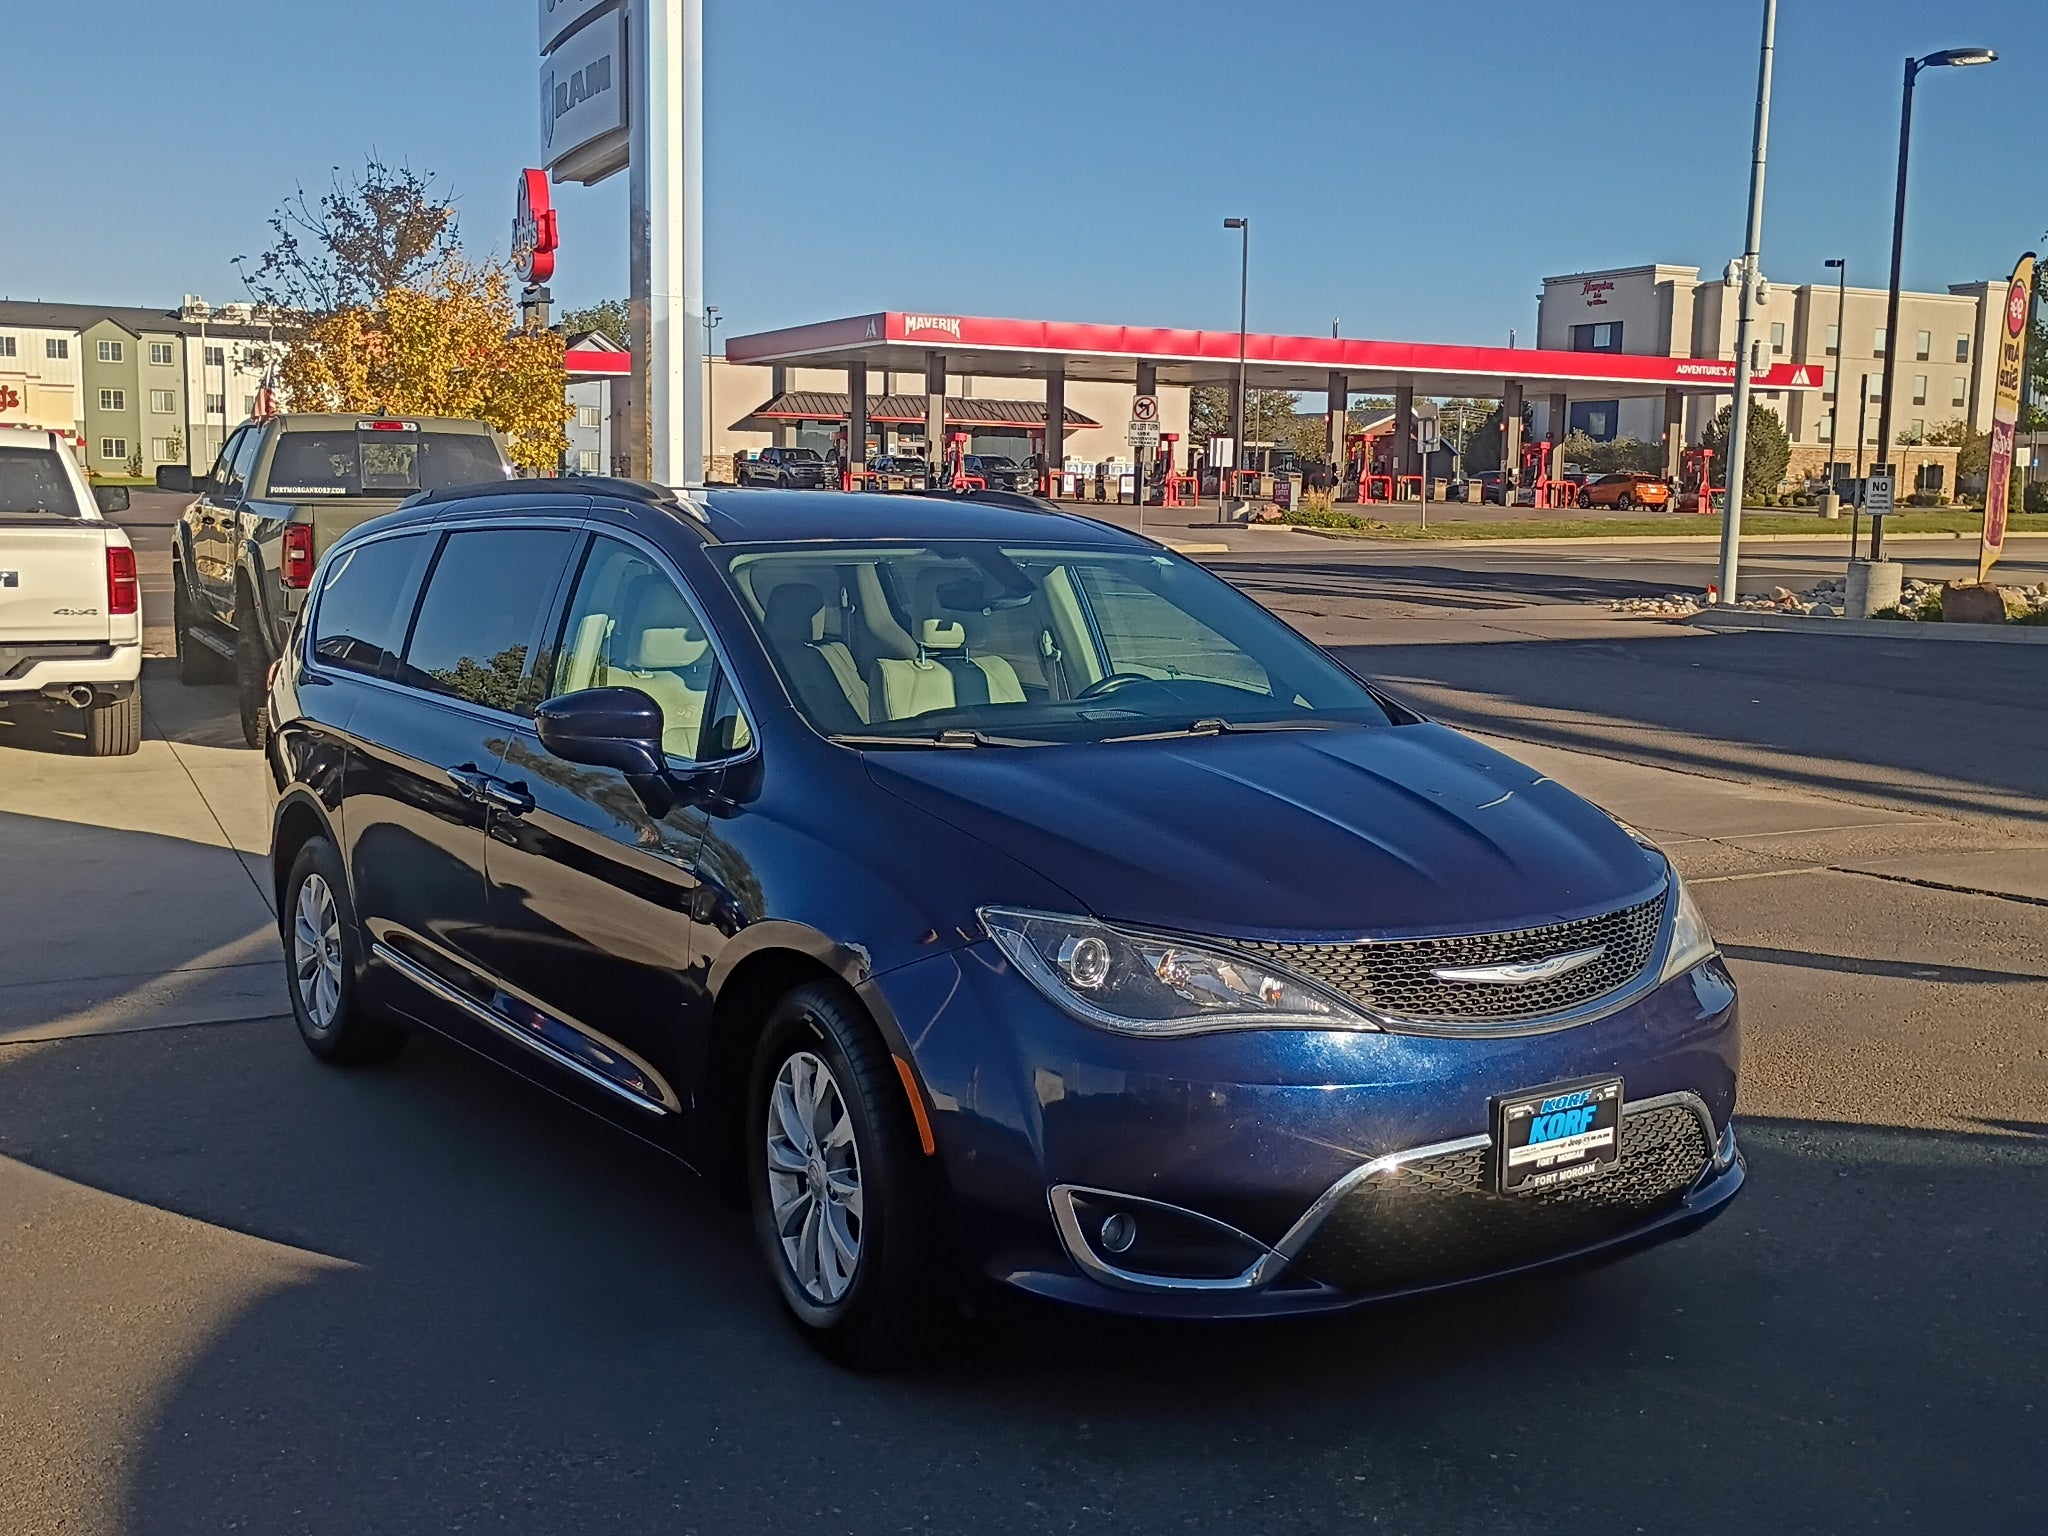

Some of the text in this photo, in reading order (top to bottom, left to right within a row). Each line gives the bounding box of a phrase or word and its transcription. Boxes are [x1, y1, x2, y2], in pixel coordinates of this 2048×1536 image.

[555, 54, 611, 119] RAM
[904, 315, 961, 340] MAVERIK
[1676, 364, 1728, 377] ADVENTURE'S
[1872, 481, 1888, 492] NO
[1540, 1089, 1593, 1115] KORF
[1528, 1105, 1597, 1145] KORF
[1534, 1163, 1596, 1187] FORT MORGAN
